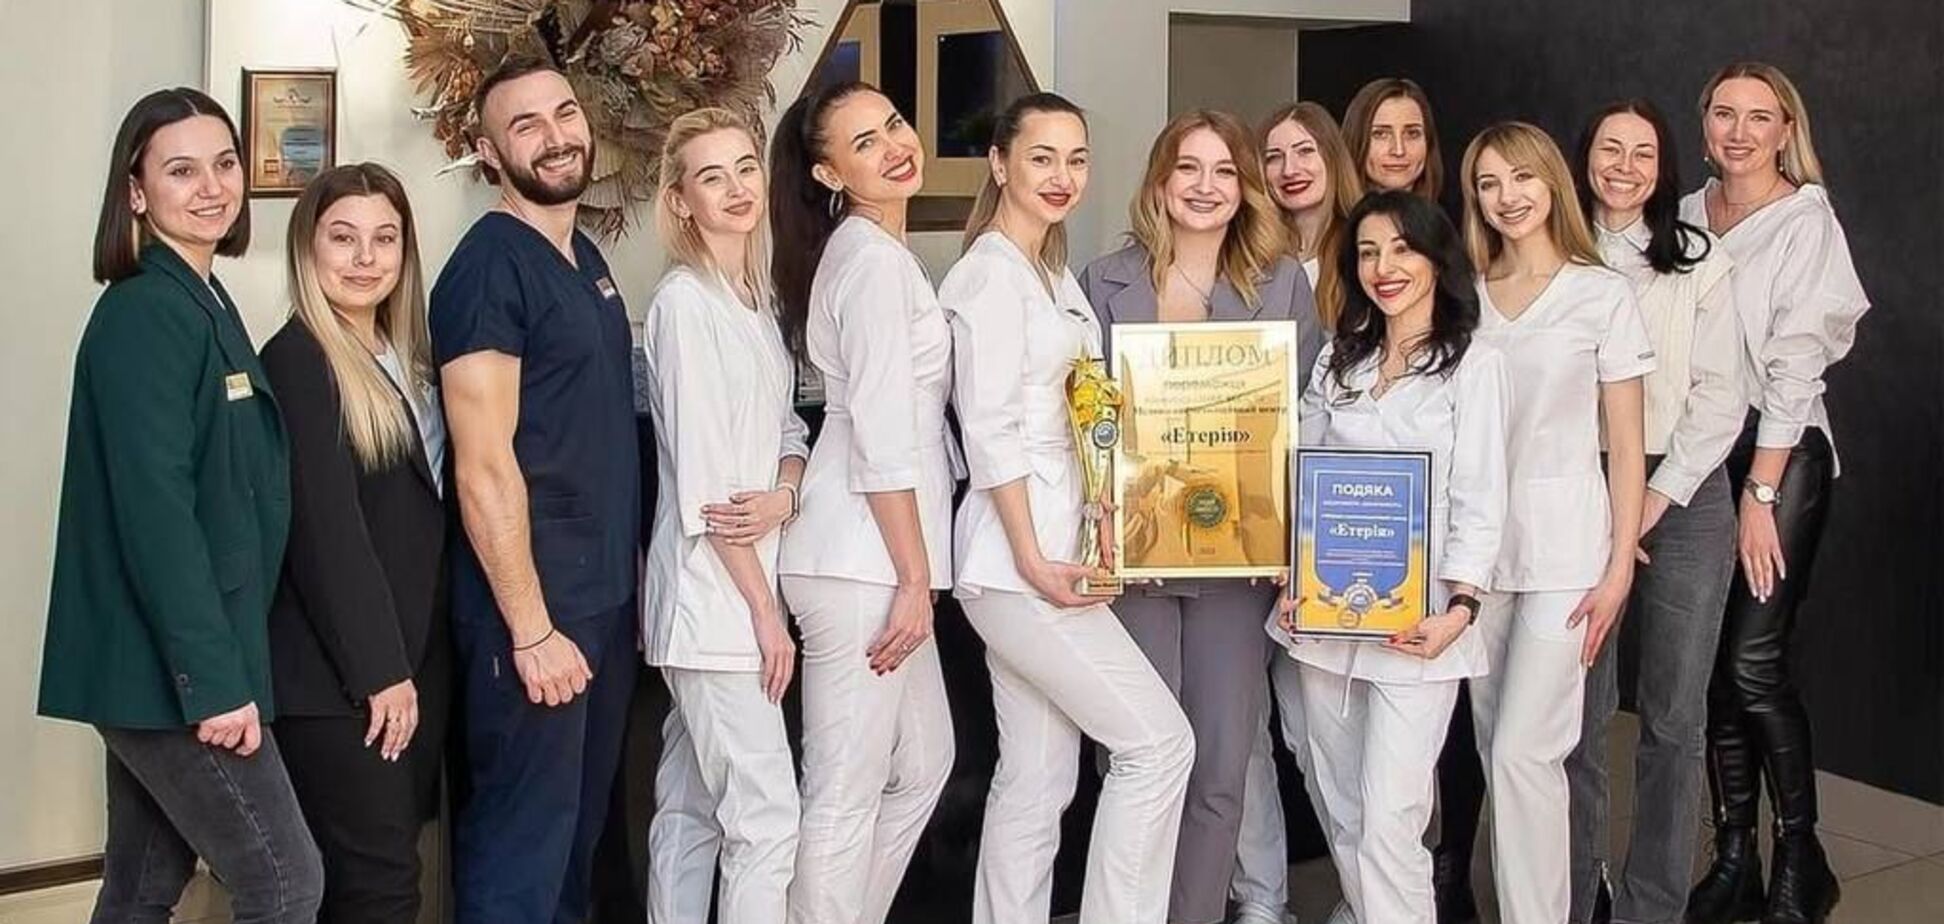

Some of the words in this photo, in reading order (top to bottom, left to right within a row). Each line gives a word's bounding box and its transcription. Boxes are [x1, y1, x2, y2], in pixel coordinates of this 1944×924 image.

[1160, 426, 1251, 447] «Етерія»
[1332, 483, 1394, 498] ПОДЯКА
[1329, 522, 1395, 541] «Етерія»
